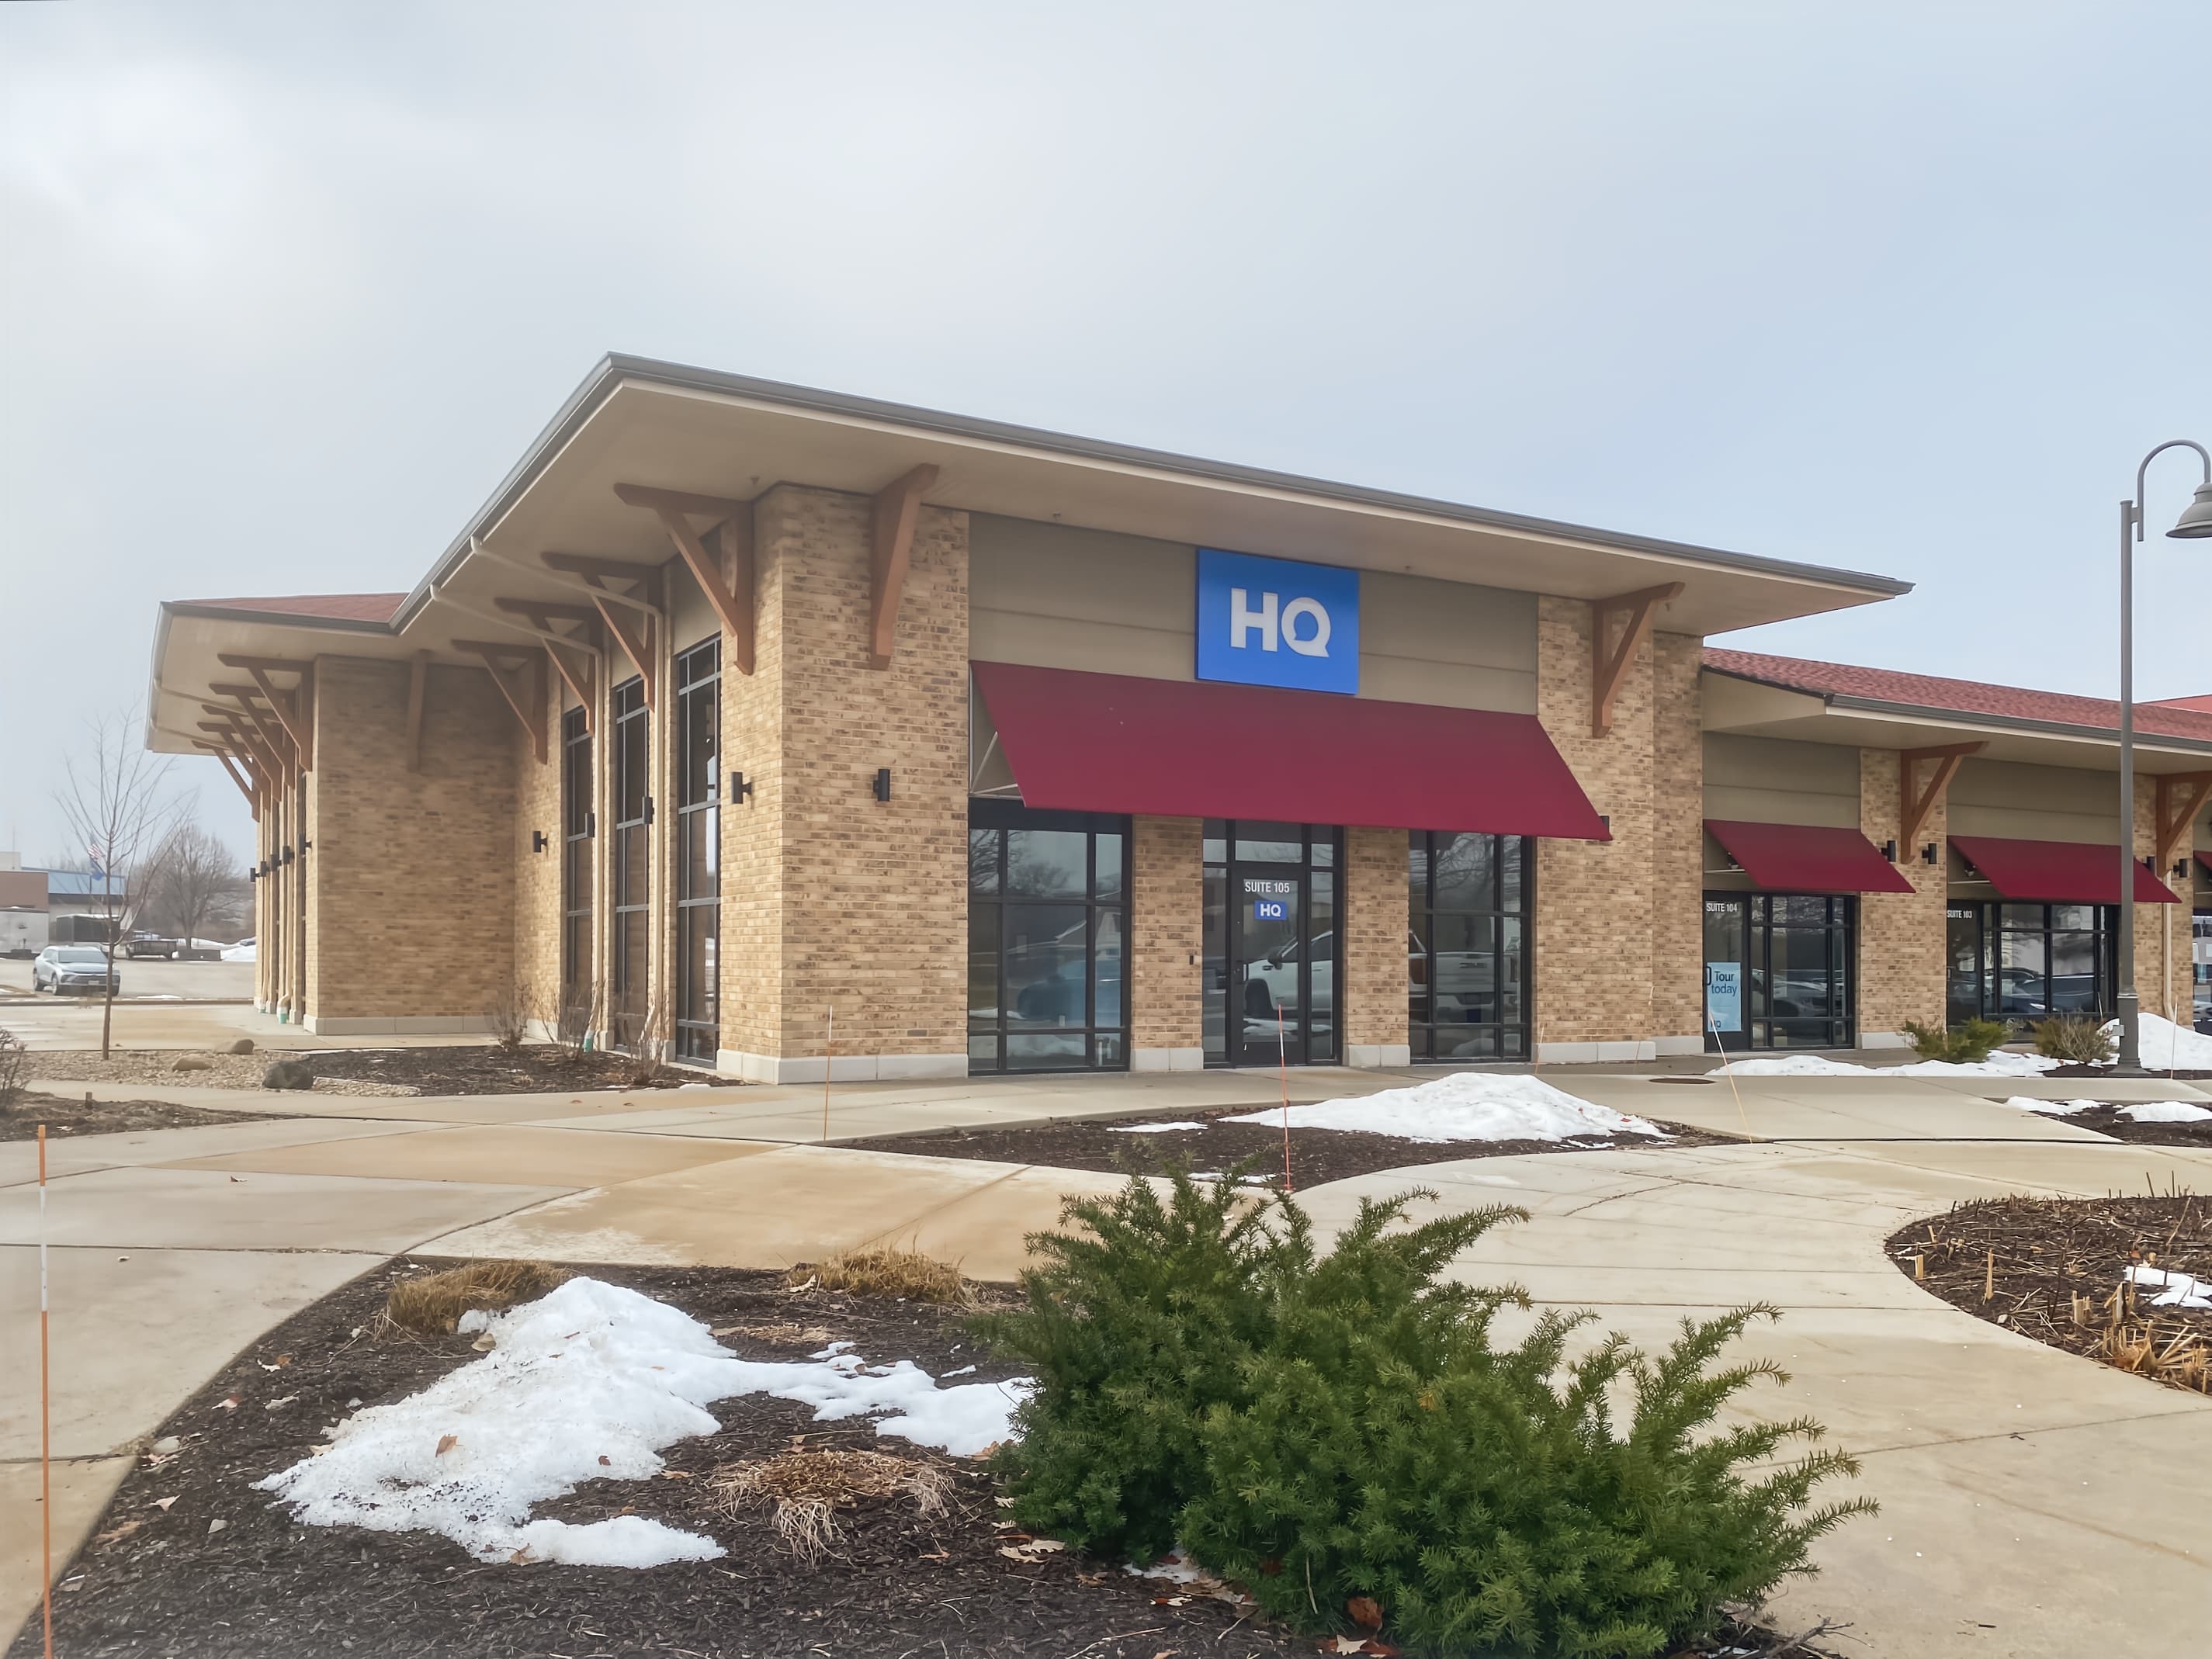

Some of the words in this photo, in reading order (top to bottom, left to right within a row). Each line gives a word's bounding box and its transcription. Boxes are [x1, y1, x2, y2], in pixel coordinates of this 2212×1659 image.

[1230, 587, 1331, 658] HQ
[1244, 881, 1271, 892] SUITE
[1274, 881, 1290, 893] 105
[1260, 903, 1281, 917] HQ
[1706, 902, 1725, 912] SUITE
[1726, 903, 1738, 913] 104
[1947, 909, 1962, 919] SUITE
[1714, 971, 1735, 982] Tour
[1711, 983, 1738, 997] today
